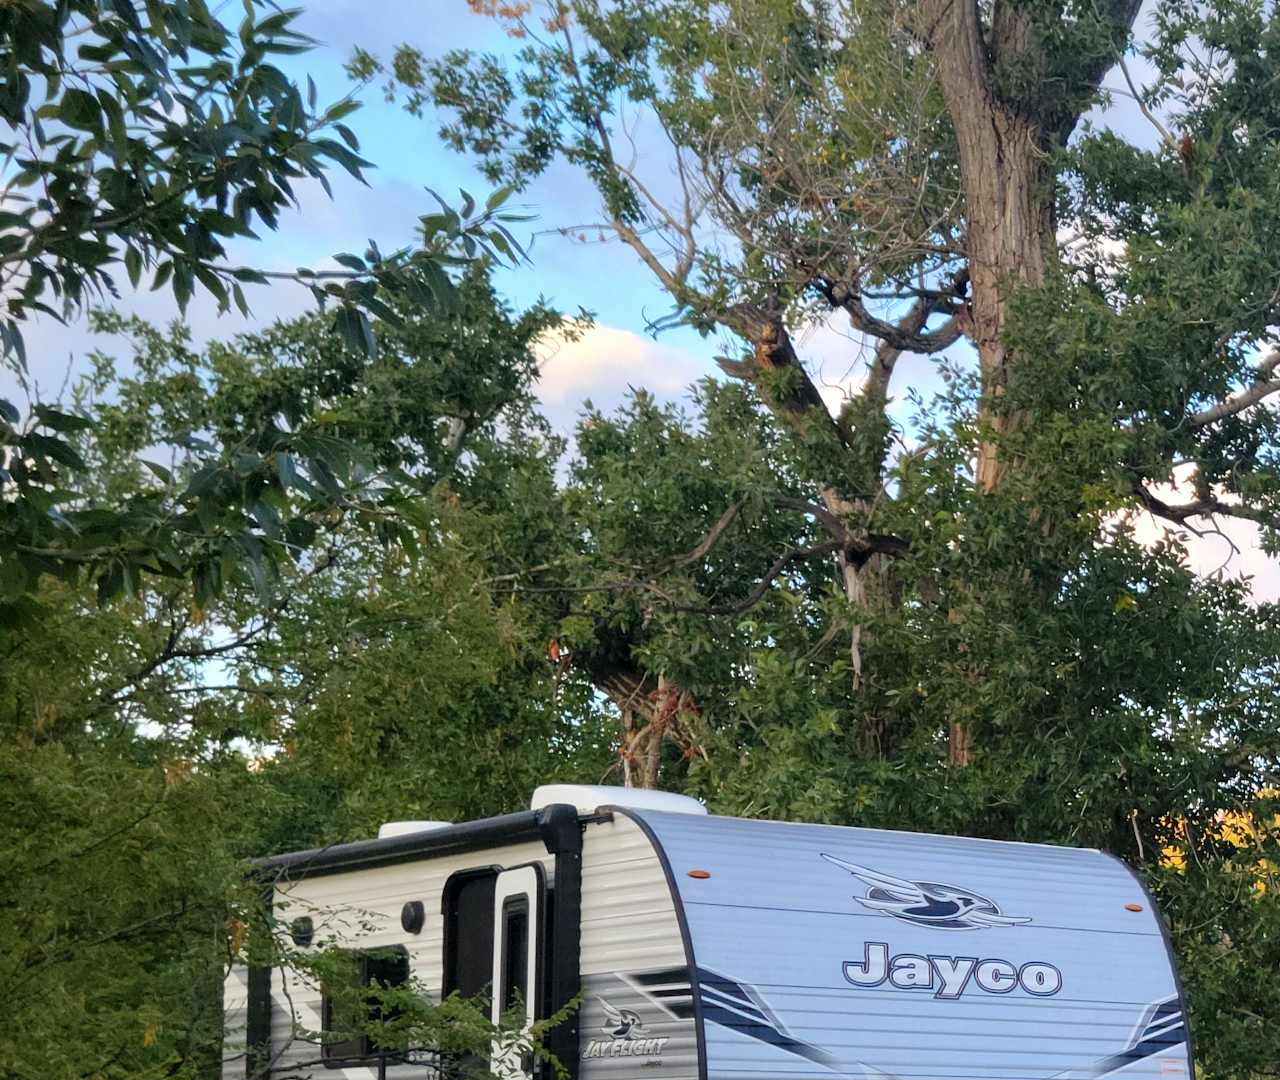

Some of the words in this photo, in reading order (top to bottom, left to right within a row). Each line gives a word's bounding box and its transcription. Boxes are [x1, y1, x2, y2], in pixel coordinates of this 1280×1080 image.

[842, 941, 1062, 999] Jayco
[581, 1039, 612, 1058] JAY
[610, 1037, 668, 1056] FLIGHT
